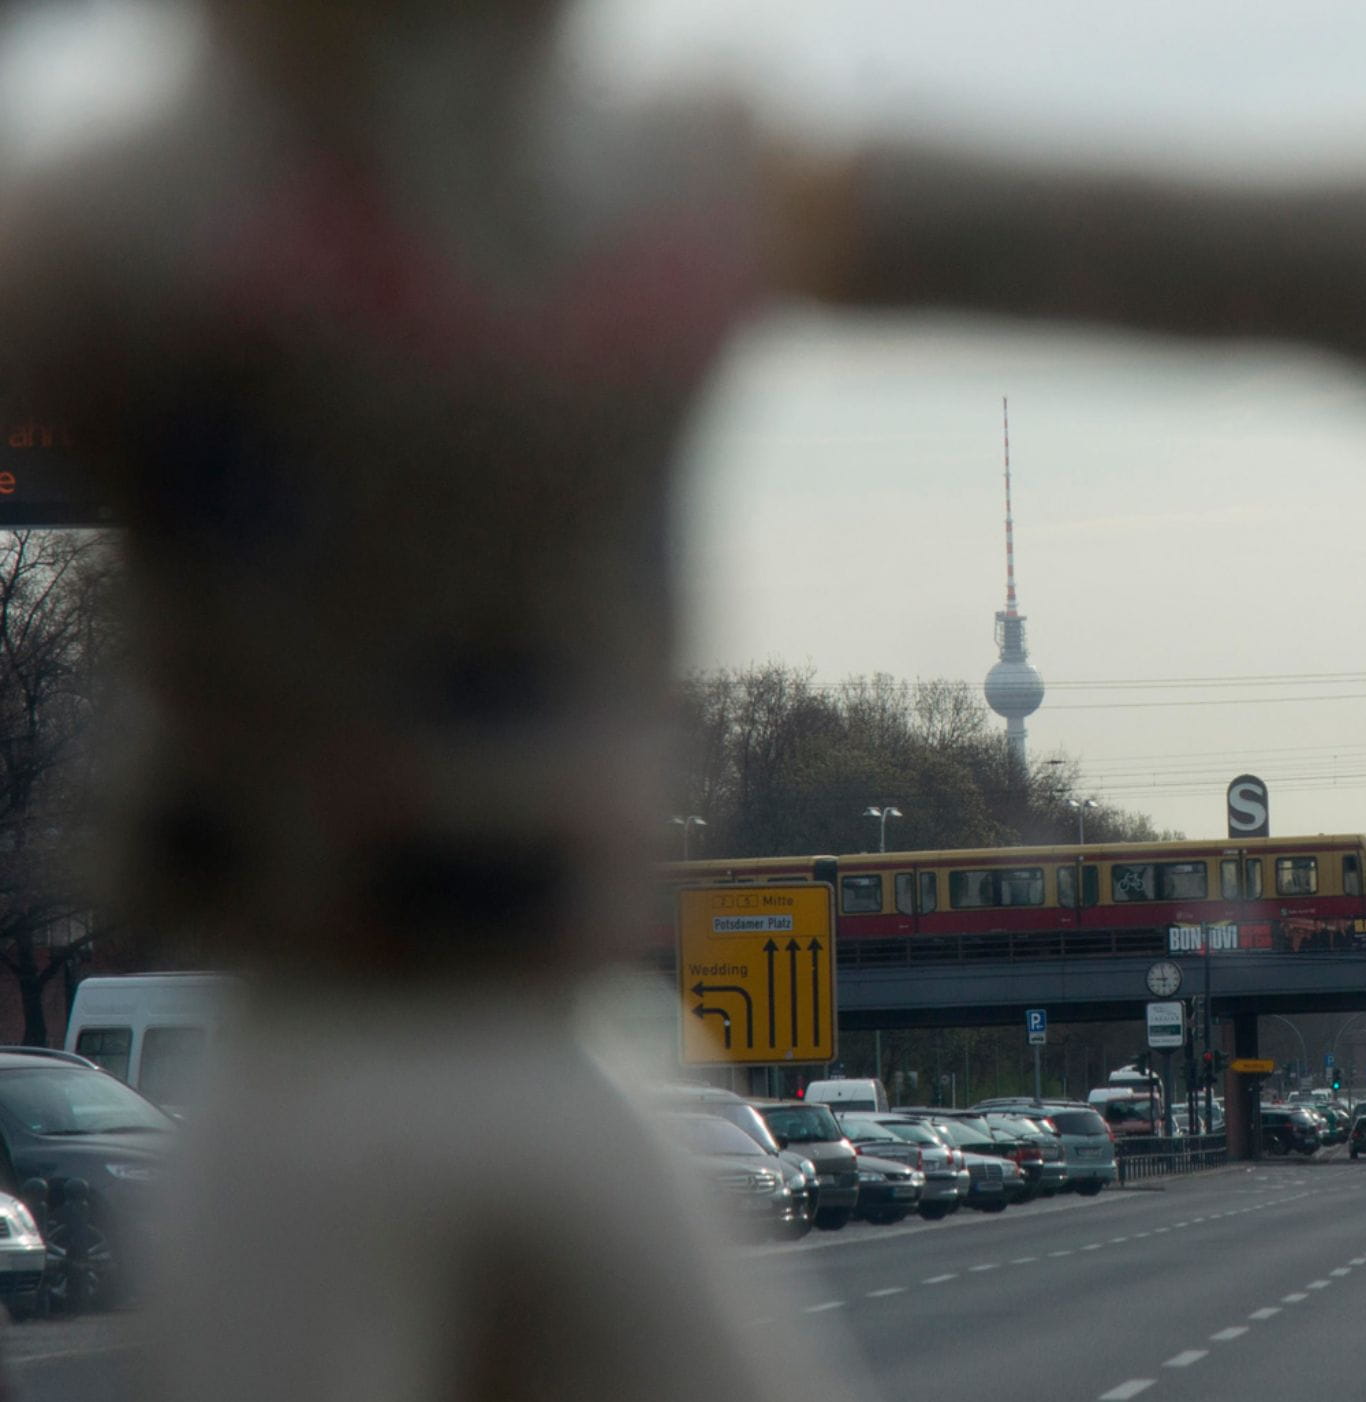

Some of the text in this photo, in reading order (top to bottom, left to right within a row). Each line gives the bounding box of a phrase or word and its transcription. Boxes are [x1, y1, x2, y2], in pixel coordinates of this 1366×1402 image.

[1229, 783, 1266, 831] S
[763, 896, 794, 906] Mitte
[714, 916, 791, 930] Potsdamer Platz
[1169, 926, 1202, 951] BON
[688, 963, 748, 977] Wedding
[1031, 1013, 1041, 1030] P
